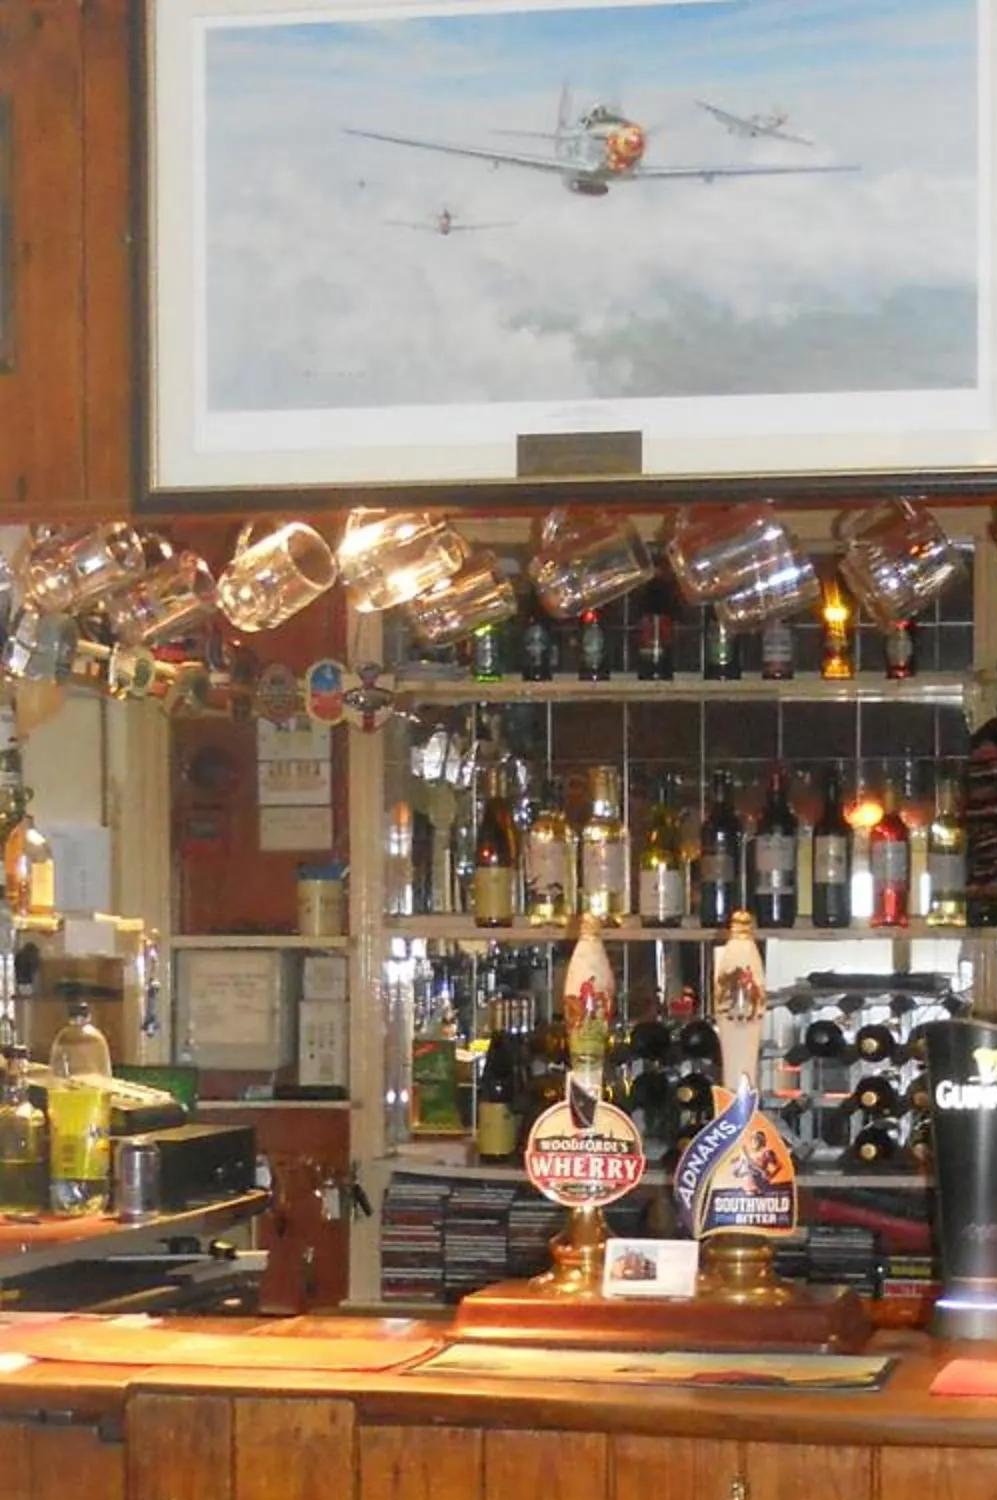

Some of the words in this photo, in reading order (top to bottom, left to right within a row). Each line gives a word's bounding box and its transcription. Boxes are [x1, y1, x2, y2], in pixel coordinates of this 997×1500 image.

[531, 1155, 637, 1180] WHERRY
[679, 1121, 738, 1209] ADNAMS
[714, 1197, 790, 1213] SOUTHWOLD
